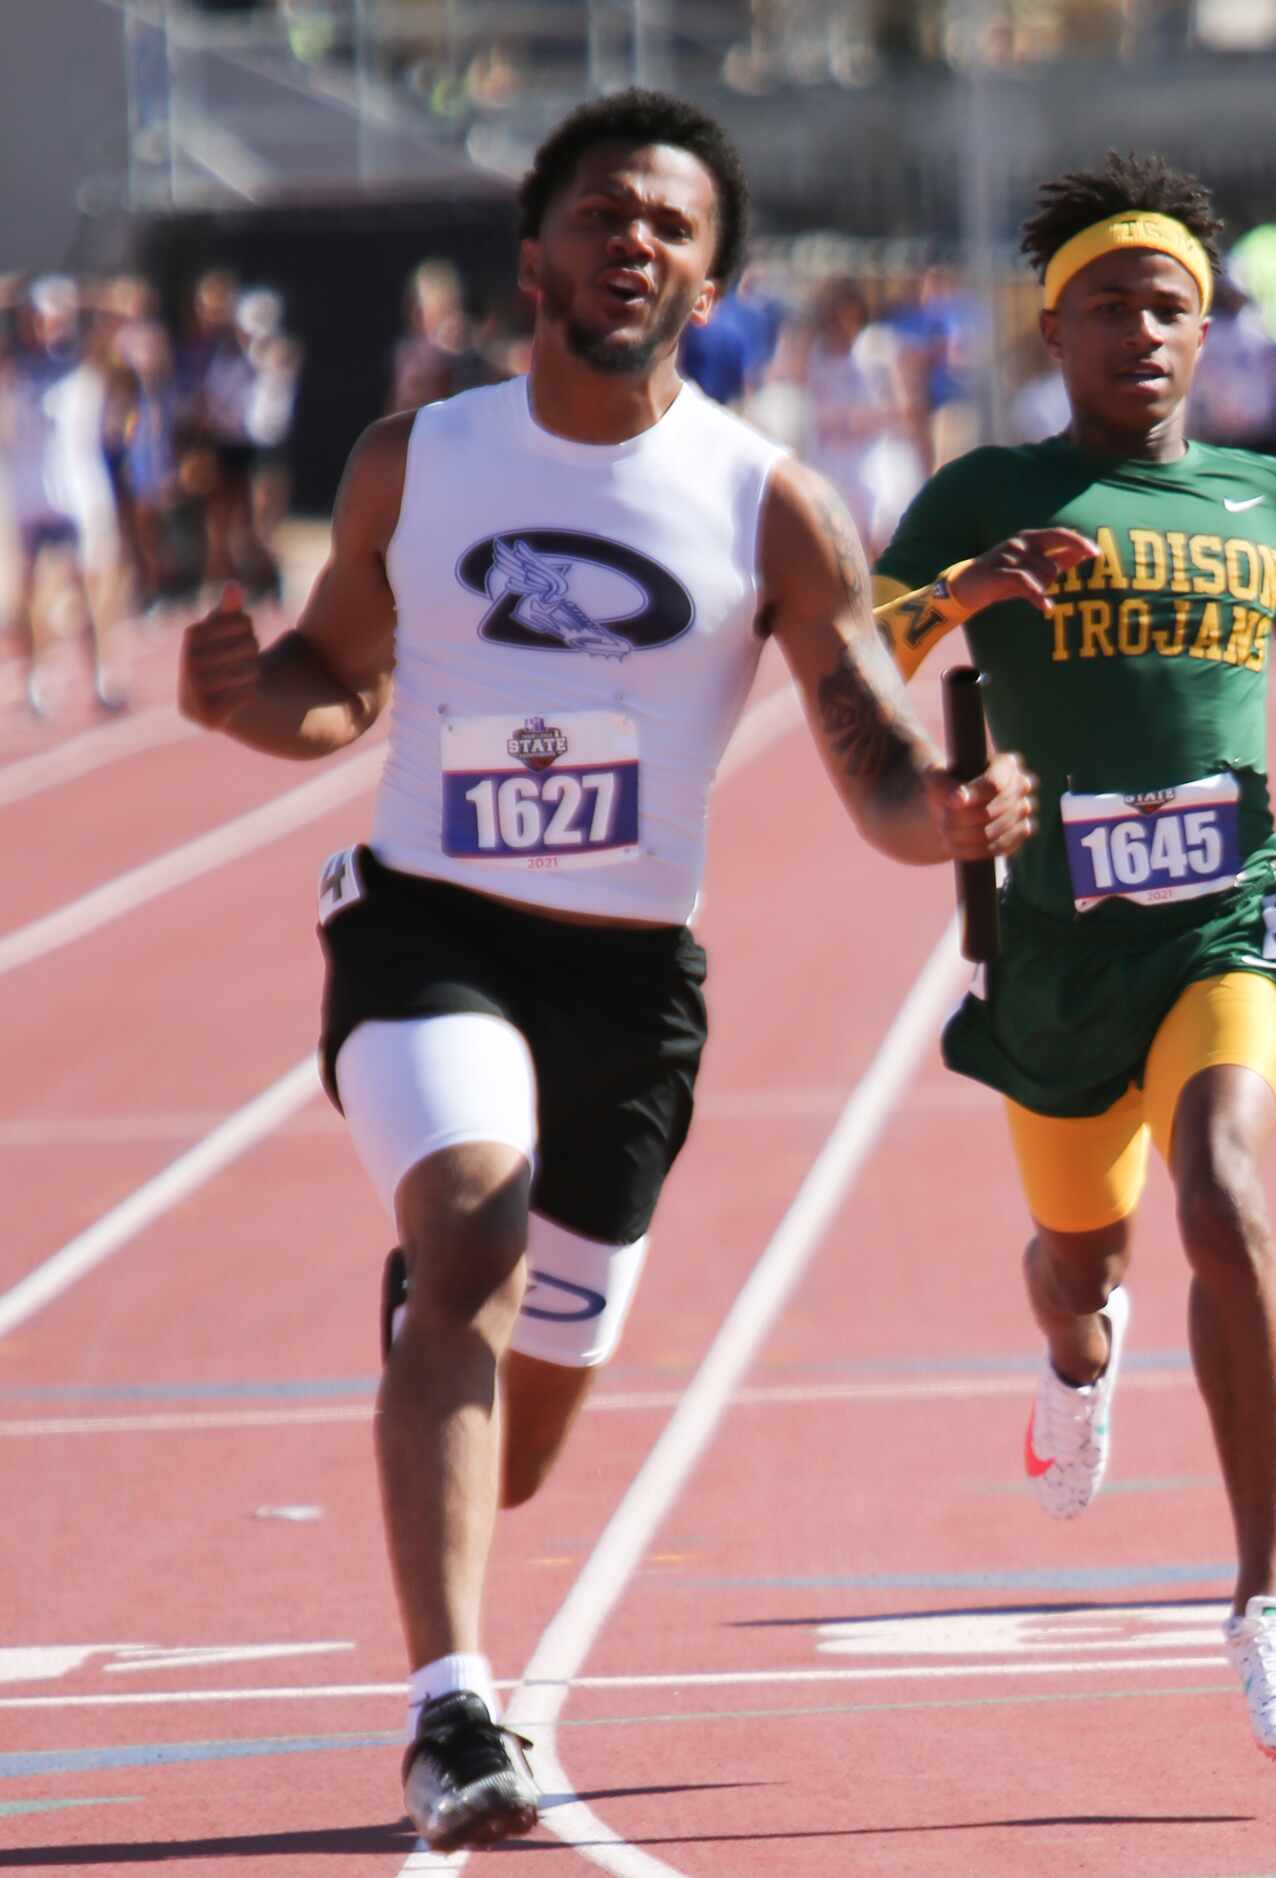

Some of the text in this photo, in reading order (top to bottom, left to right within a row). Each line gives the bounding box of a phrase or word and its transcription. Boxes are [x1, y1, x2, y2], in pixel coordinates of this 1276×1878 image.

[507, 737, 567, 754] STATE
[465, 772, 616, 850] 1627
[527, 857, 559, 870] 2021
[1080, 810, 1223, 889] 1645
